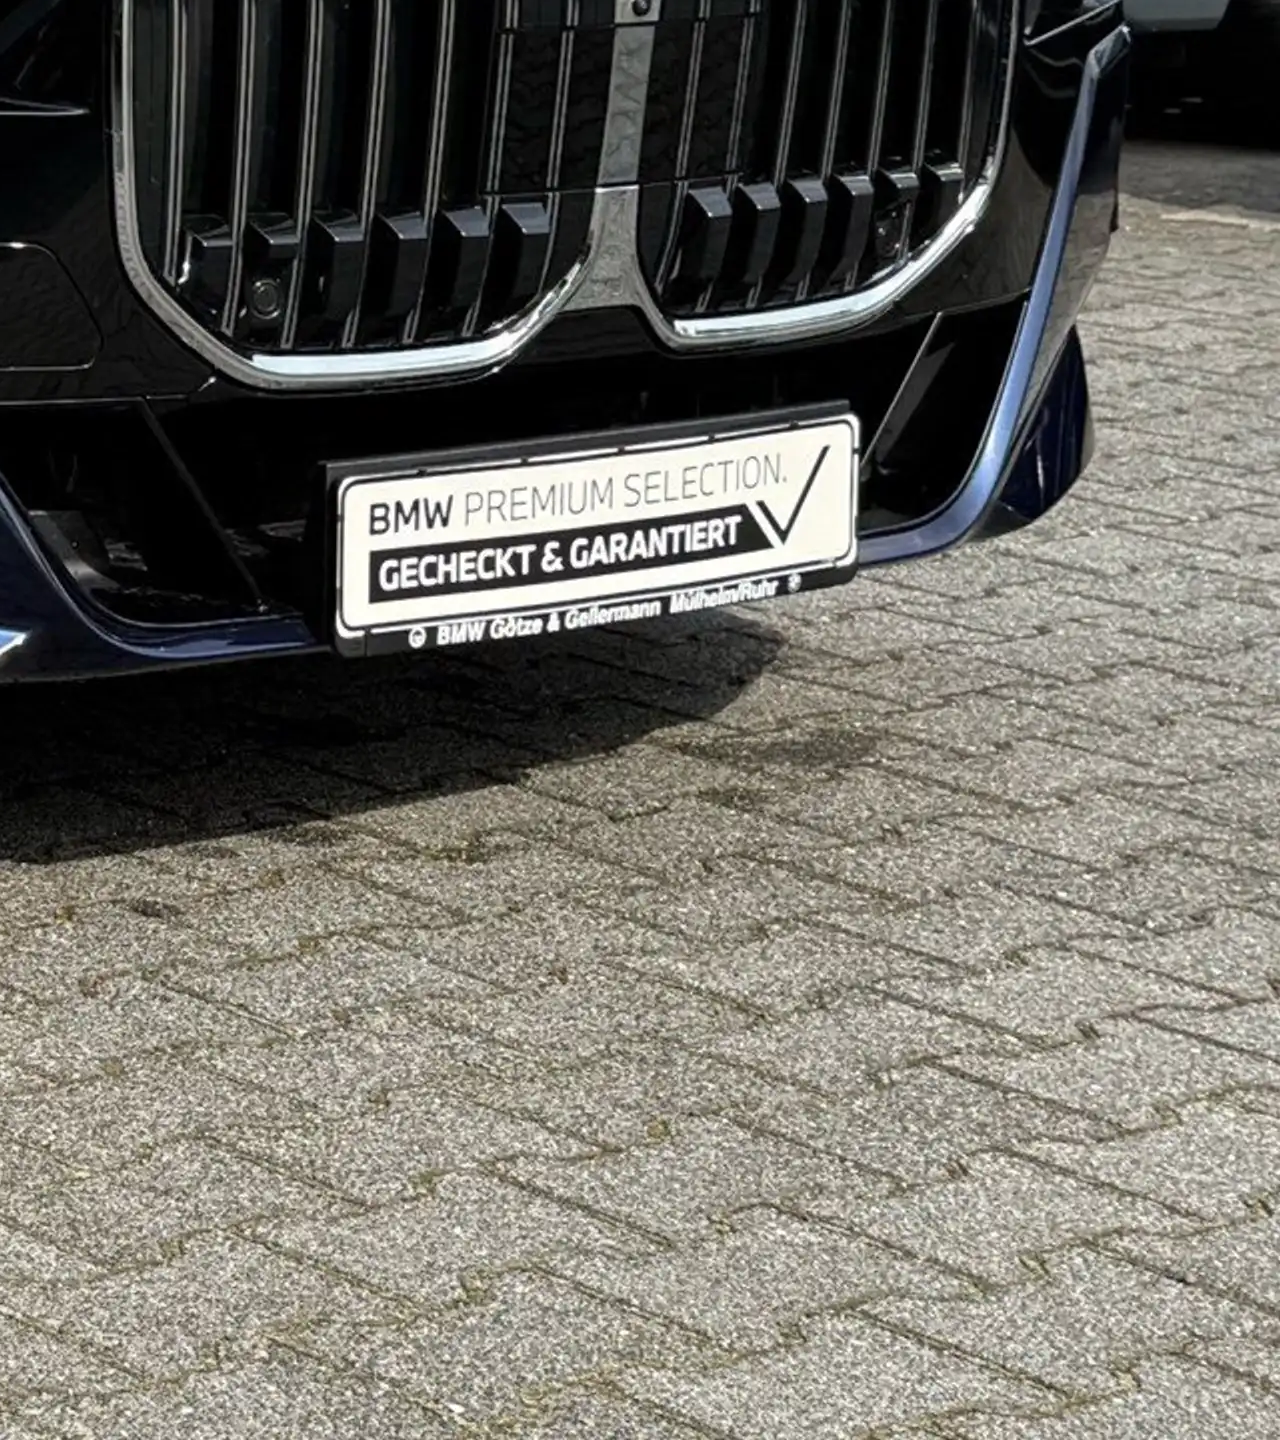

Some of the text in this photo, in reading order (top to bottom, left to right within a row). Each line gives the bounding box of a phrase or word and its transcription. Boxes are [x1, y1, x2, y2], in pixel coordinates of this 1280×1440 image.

[369, 454, 788, 536] BMW PREMIUM SELECTION.
[379, 516, 742, 591] GECHECKT & GARANTIERT
[436, 621, 486, 645] BMW
[490, 616, 543, 639] Götze
[546, 611, 561, 633] &
[565, 599, 661, 629] Gellermann
